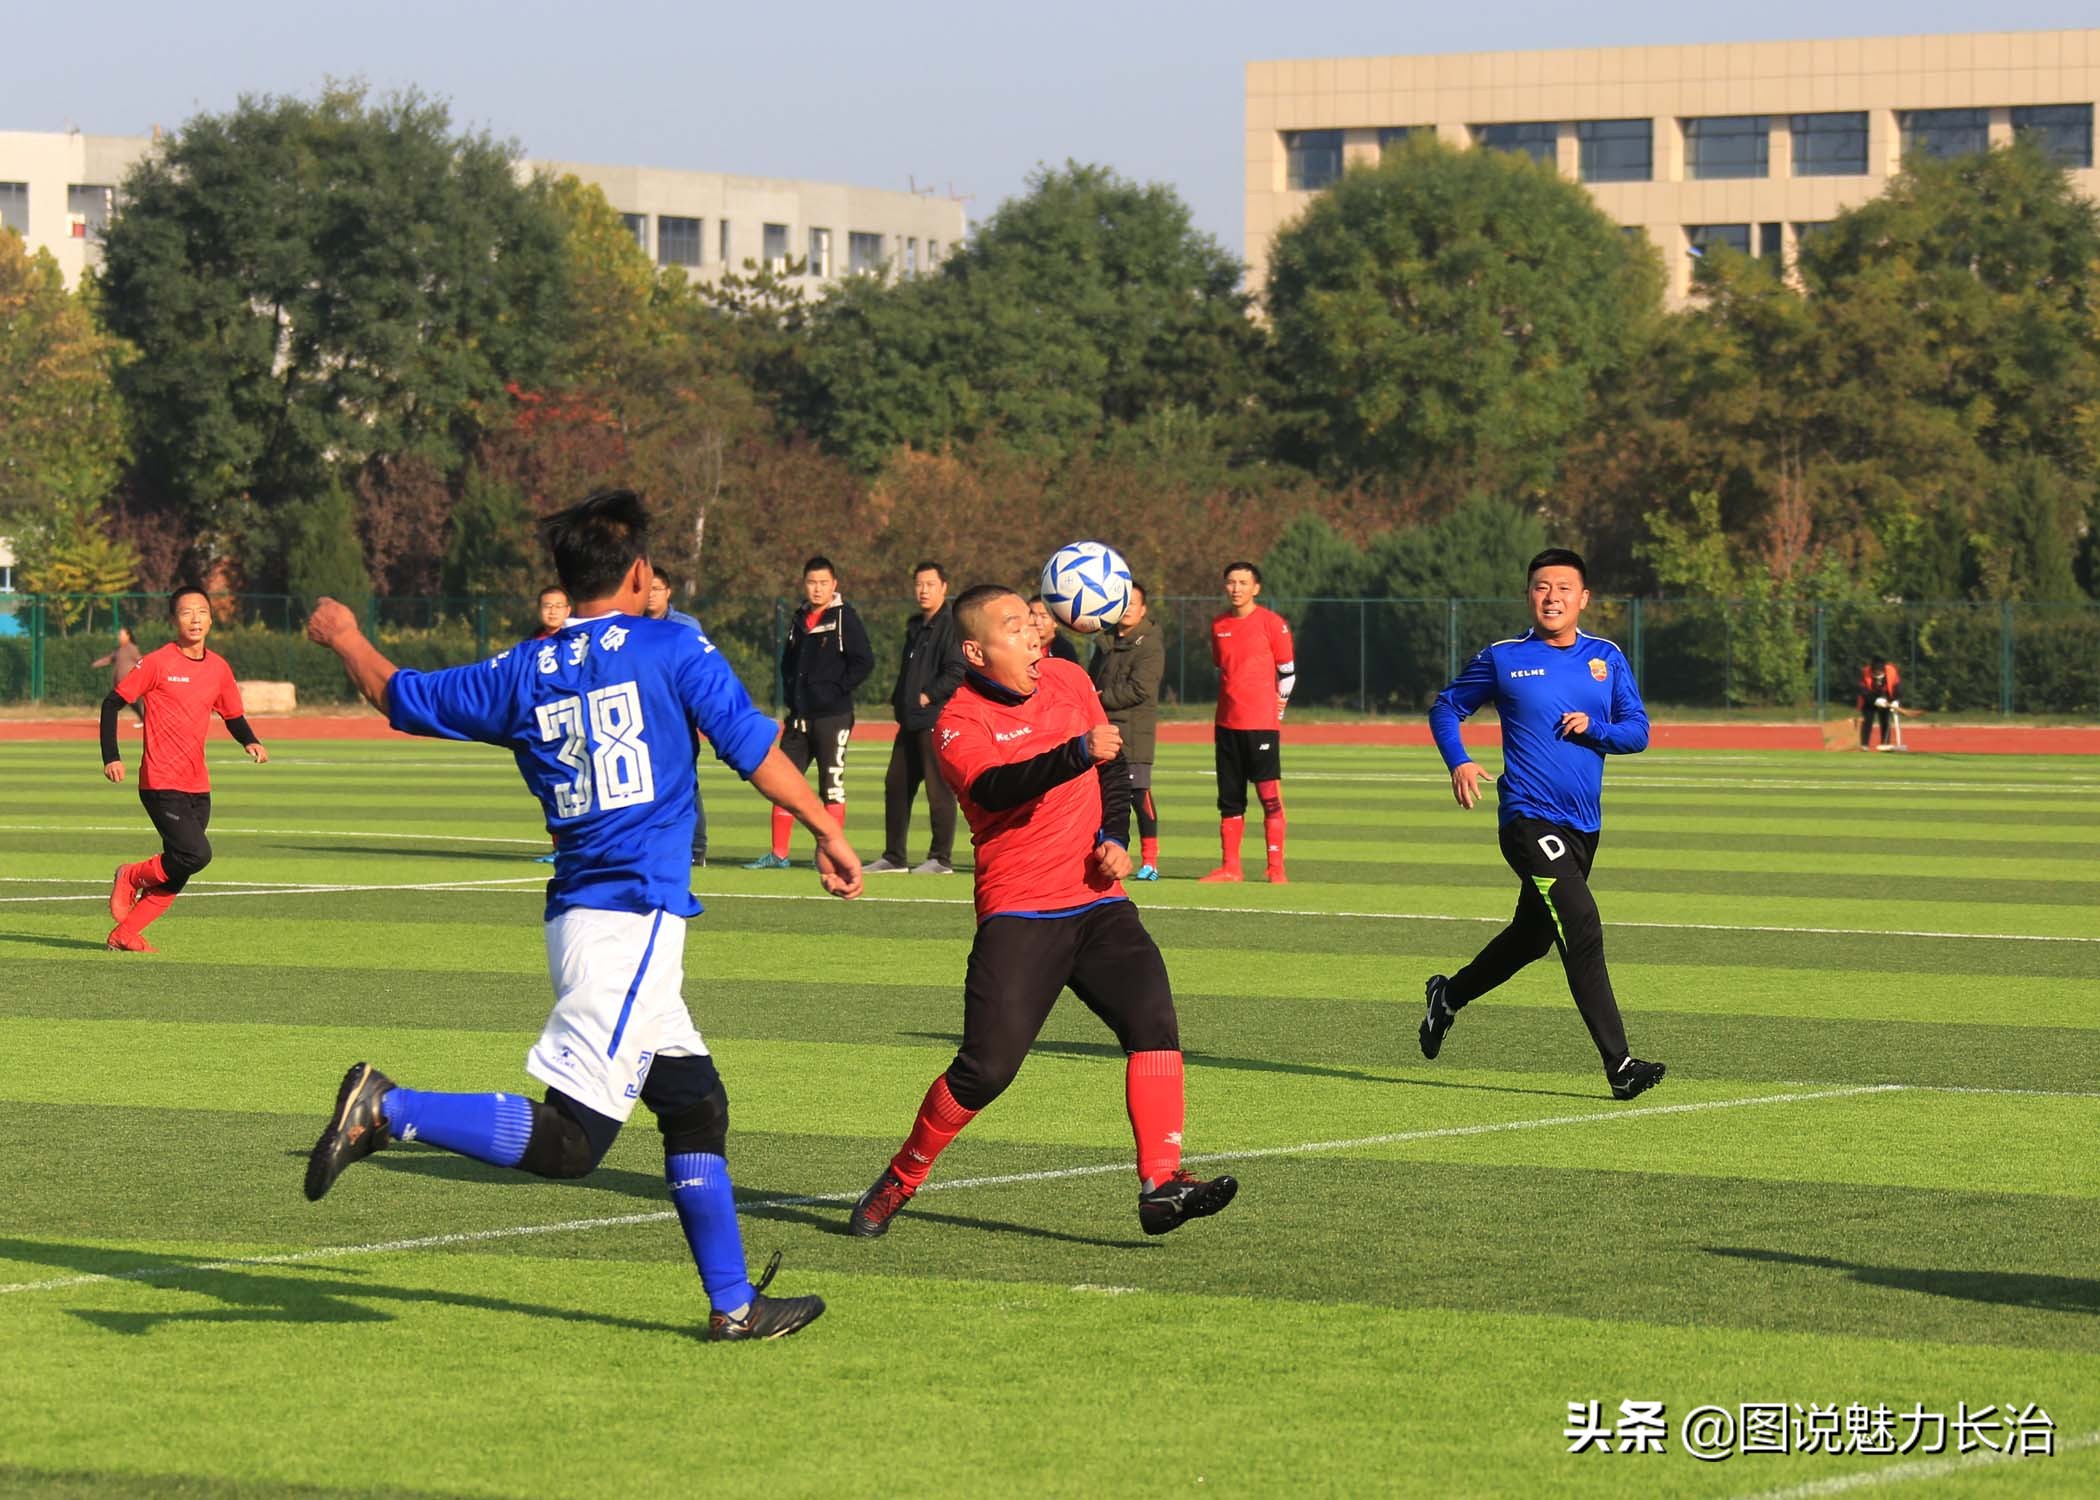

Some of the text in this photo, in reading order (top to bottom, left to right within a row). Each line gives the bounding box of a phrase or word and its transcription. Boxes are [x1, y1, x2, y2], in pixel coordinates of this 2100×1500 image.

[1510, 668, 1545, 678] KELME
[995, 727, 1032, 741] KELME
[535, 680, 654, 818] 38
[1537, 834, 1566, 861] D
